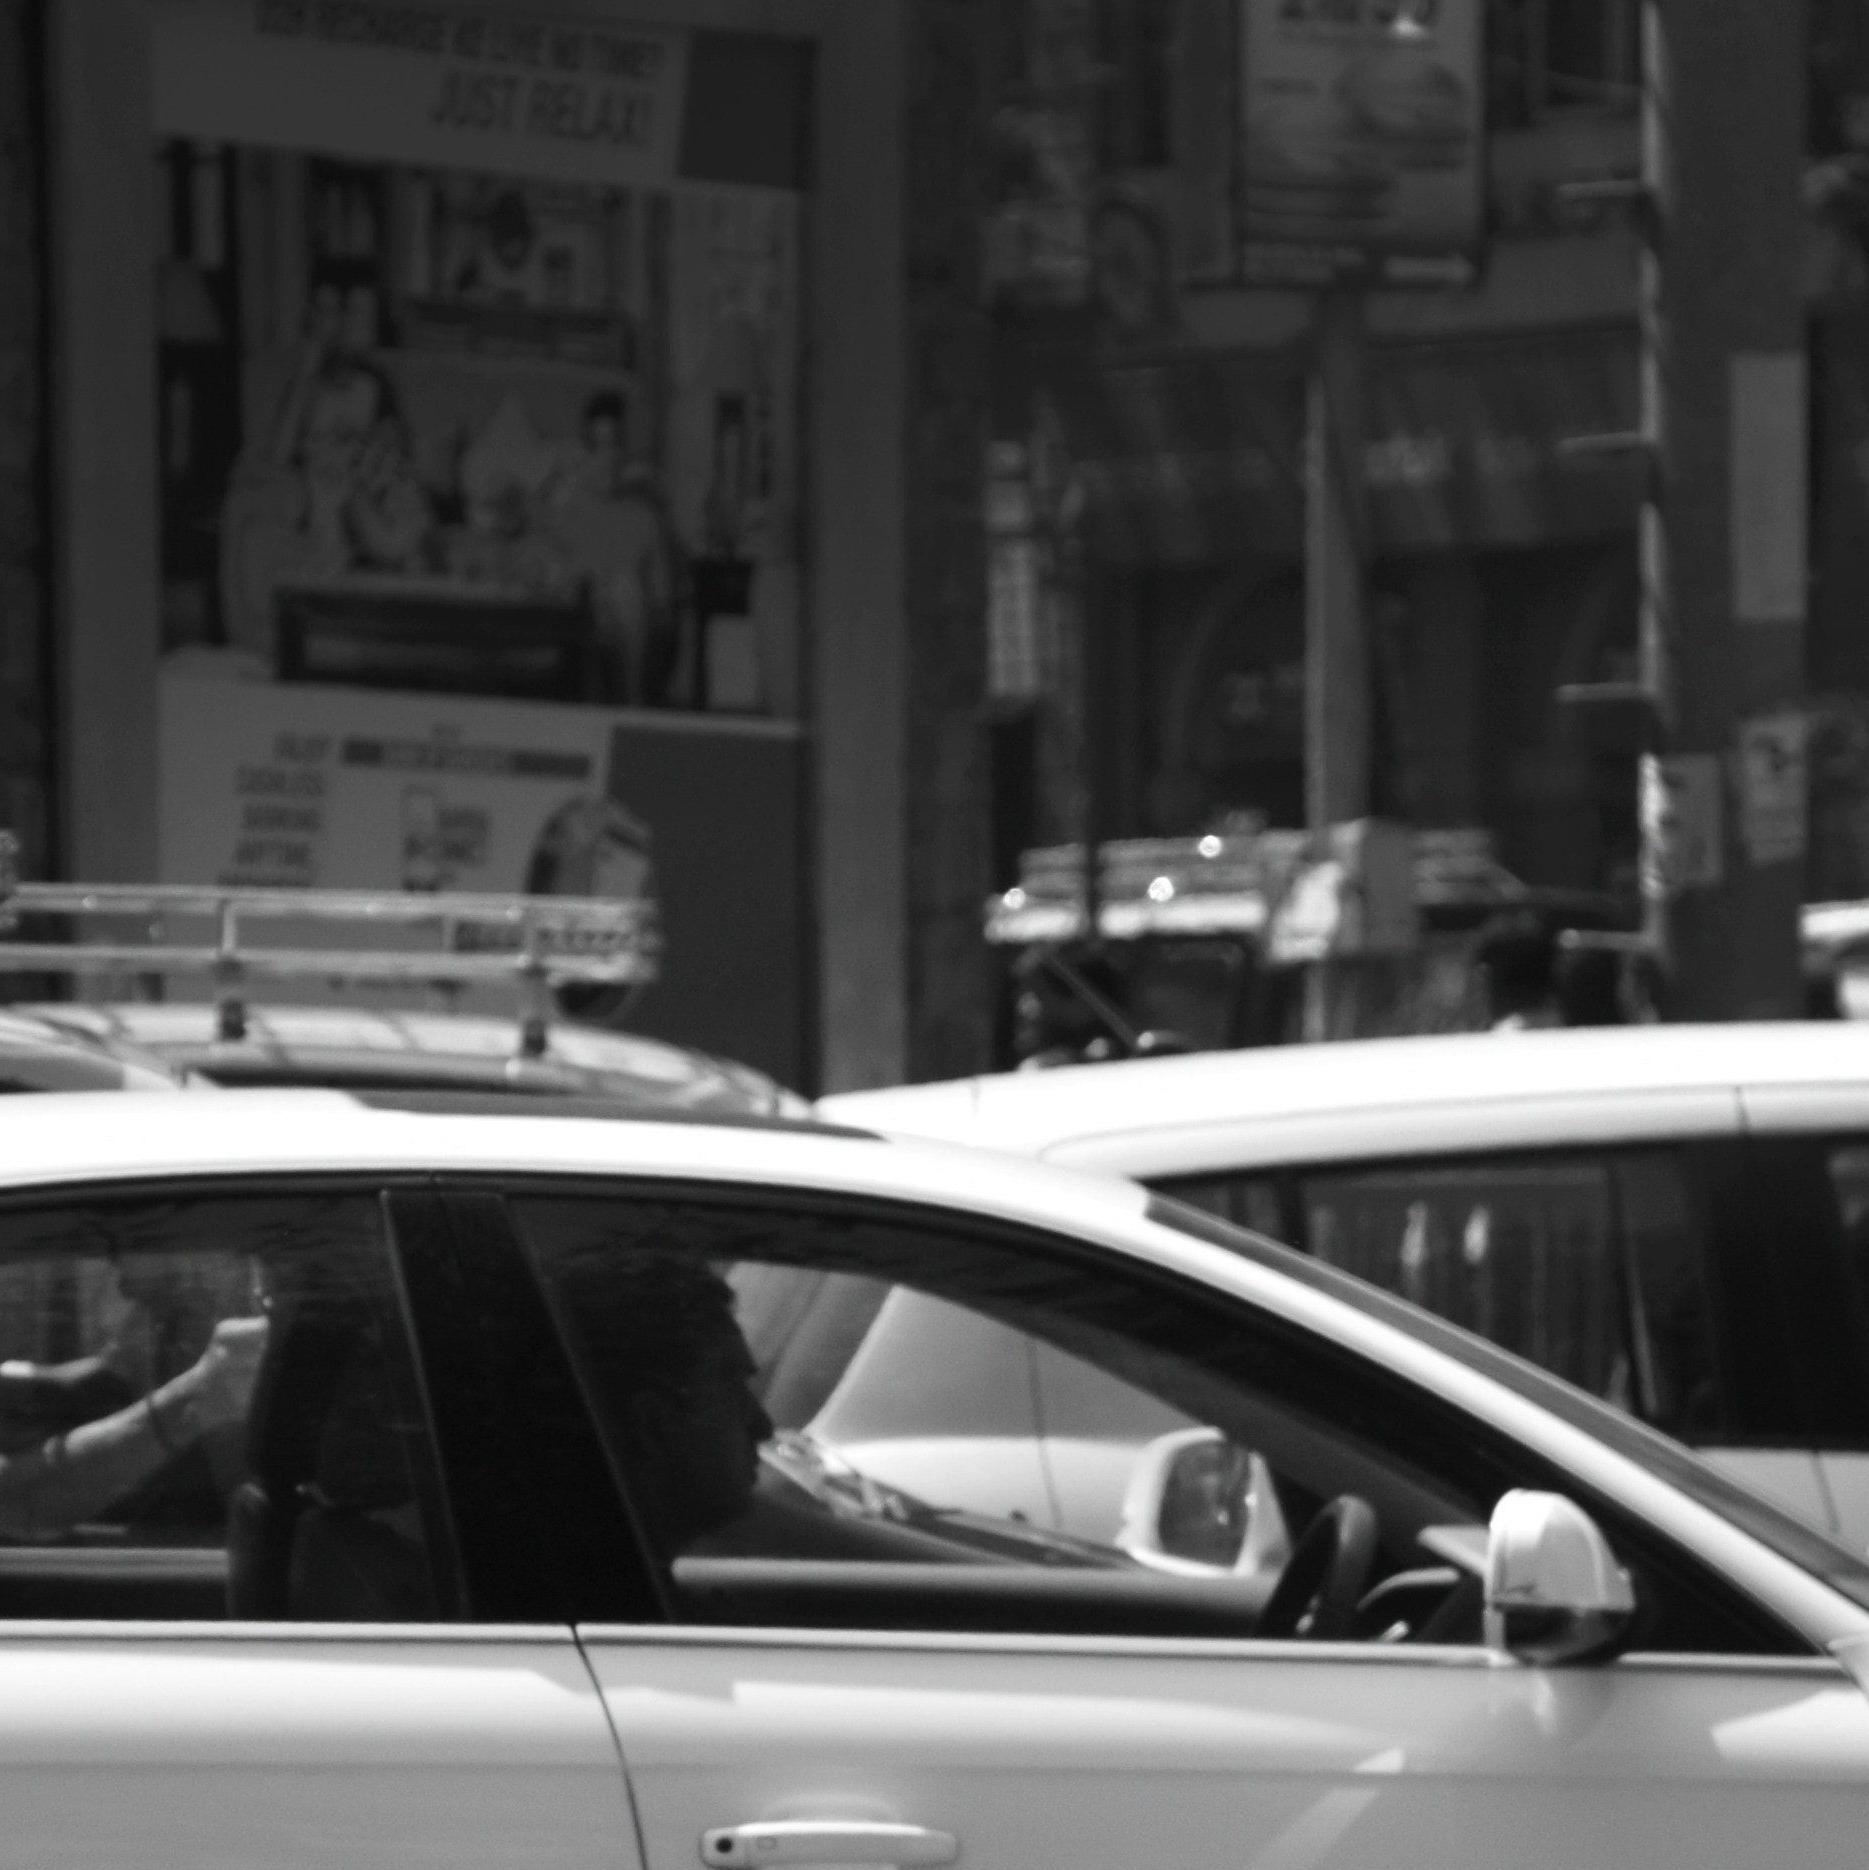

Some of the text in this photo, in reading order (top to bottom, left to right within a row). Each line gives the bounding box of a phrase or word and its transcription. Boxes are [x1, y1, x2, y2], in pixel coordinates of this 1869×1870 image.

[312, 0, 447, 55] RECHARGE
[429, 68, 656, 148] JUST RELAX!
